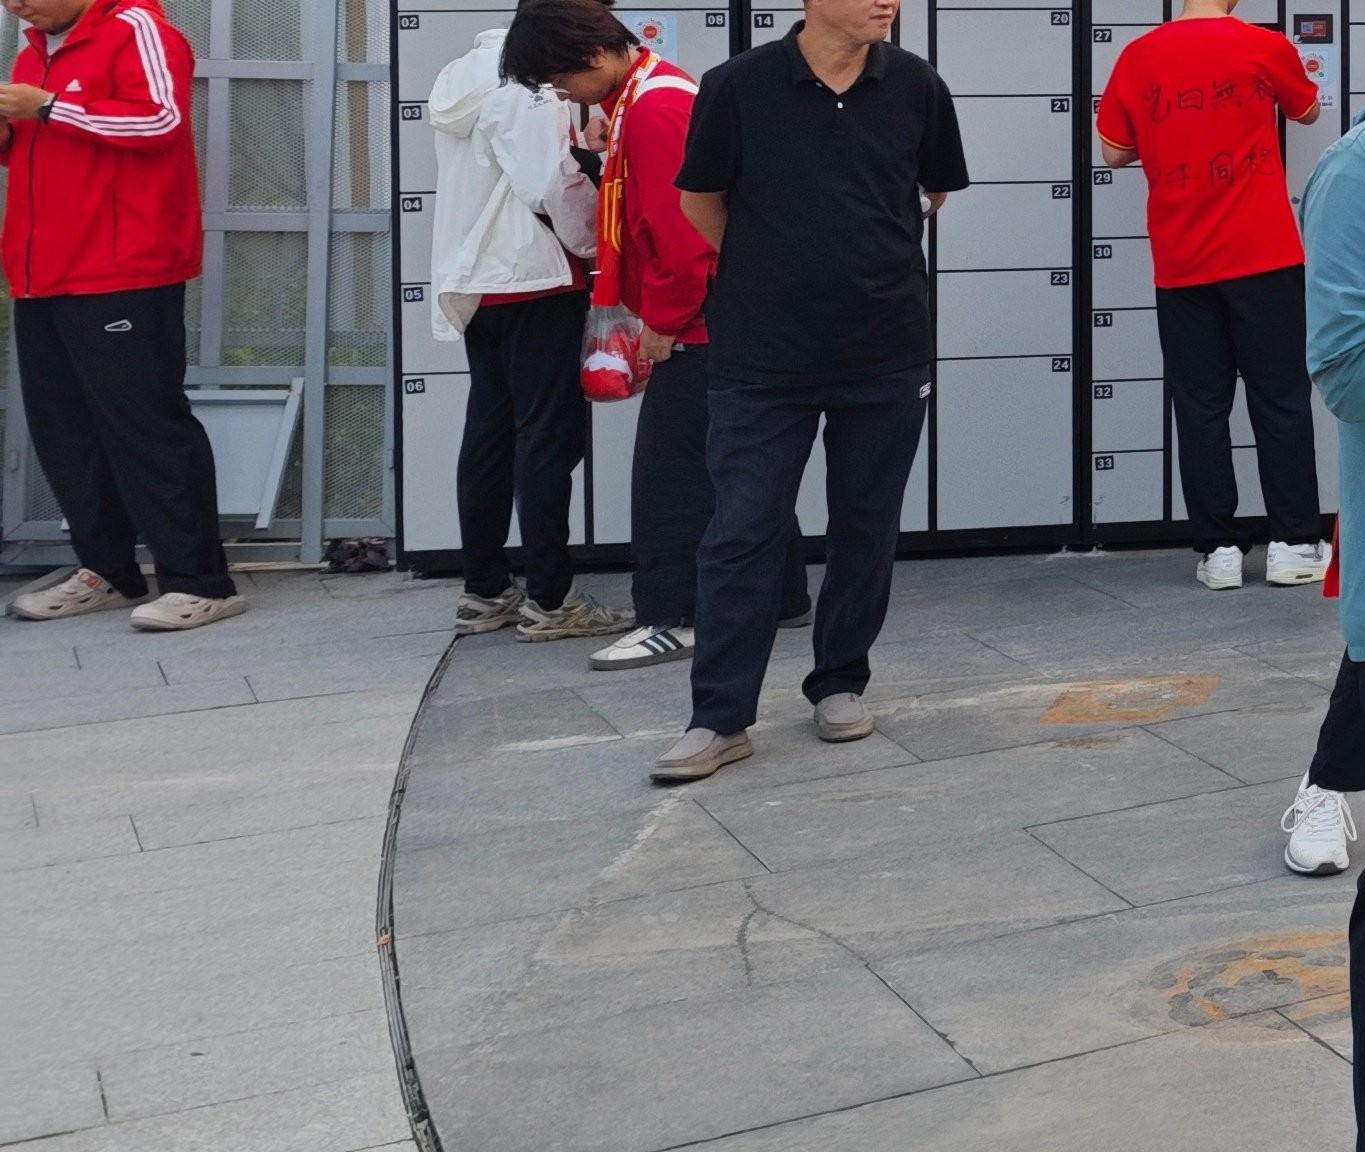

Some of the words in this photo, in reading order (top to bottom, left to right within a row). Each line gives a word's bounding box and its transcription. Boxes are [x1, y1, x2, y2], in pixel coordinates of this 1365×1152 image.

[400, 16, 418, 28] 02
[707, 14, 724, 25] 08
[756, 15, 772, 26] 14
[1052, 13, 1069, 24] 20
[1095, 30, 1111, 41] 27
[1053, 100, 1068, 111] 21
[403, 107, 420, 119] 03
[1095, 172, 1111, 184] 29
[1053, 186, 1069, 197] 22
[403, 199, 421, 211] 04
[1095, 246, 1111, 258] 30
[1052, 273, 1068, 284] 23
[405, 289, 422, 301] 05
[1096, 314, 1111, 326] 31
[1053, 359, 1069, 370] 24
[406, 380, 424, 392] 06
[1095, 386, 1111, 398] 32
[1097, 457, 1113, 469] 33
